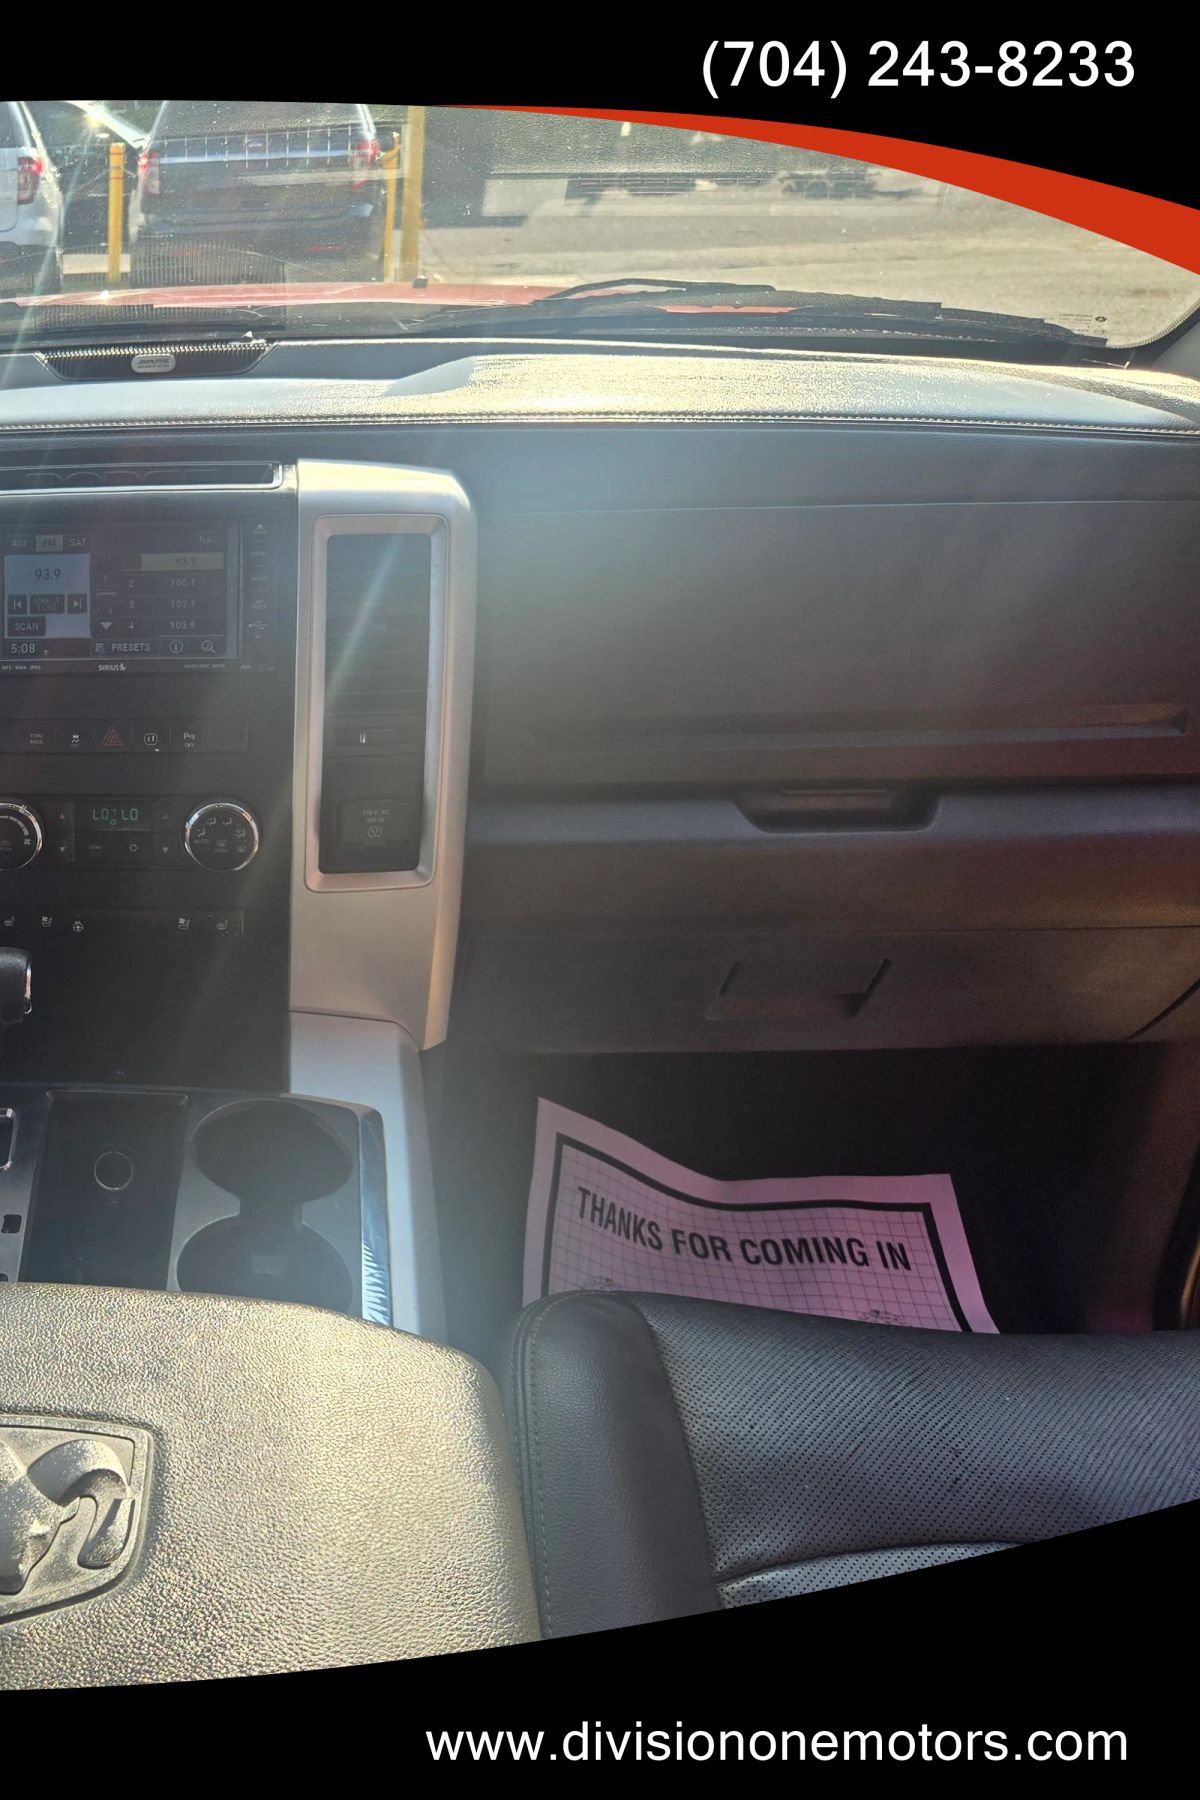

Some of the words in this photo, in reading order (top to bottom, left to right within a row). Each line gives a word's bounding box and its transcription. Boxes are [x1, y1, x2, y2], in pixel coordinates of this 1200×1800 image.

[69, 537, 87, 547] SAT
[34, 567, 62, 580] 93.9
[128, 579, 136, 590] 2
[128, 600, 136, 609] 3
[14, 623, 39, 632] SCAN
[169, 620, 197, 630] 103.9
[10, 643, 36, 654] 5:08
[111, 642, 151, 653] PRESETS
[98, 664, 120, 672] SIRIUS
[92, 808, 109, 821] LO
[121, 807, 139, 821] LO
[578, 1186, 663, 1251] THANKS
[671, 1228, 733, 1262] FOR
[739, 1236, 870, 1268] COMING
[875, 1240, 912, 1271] IN
